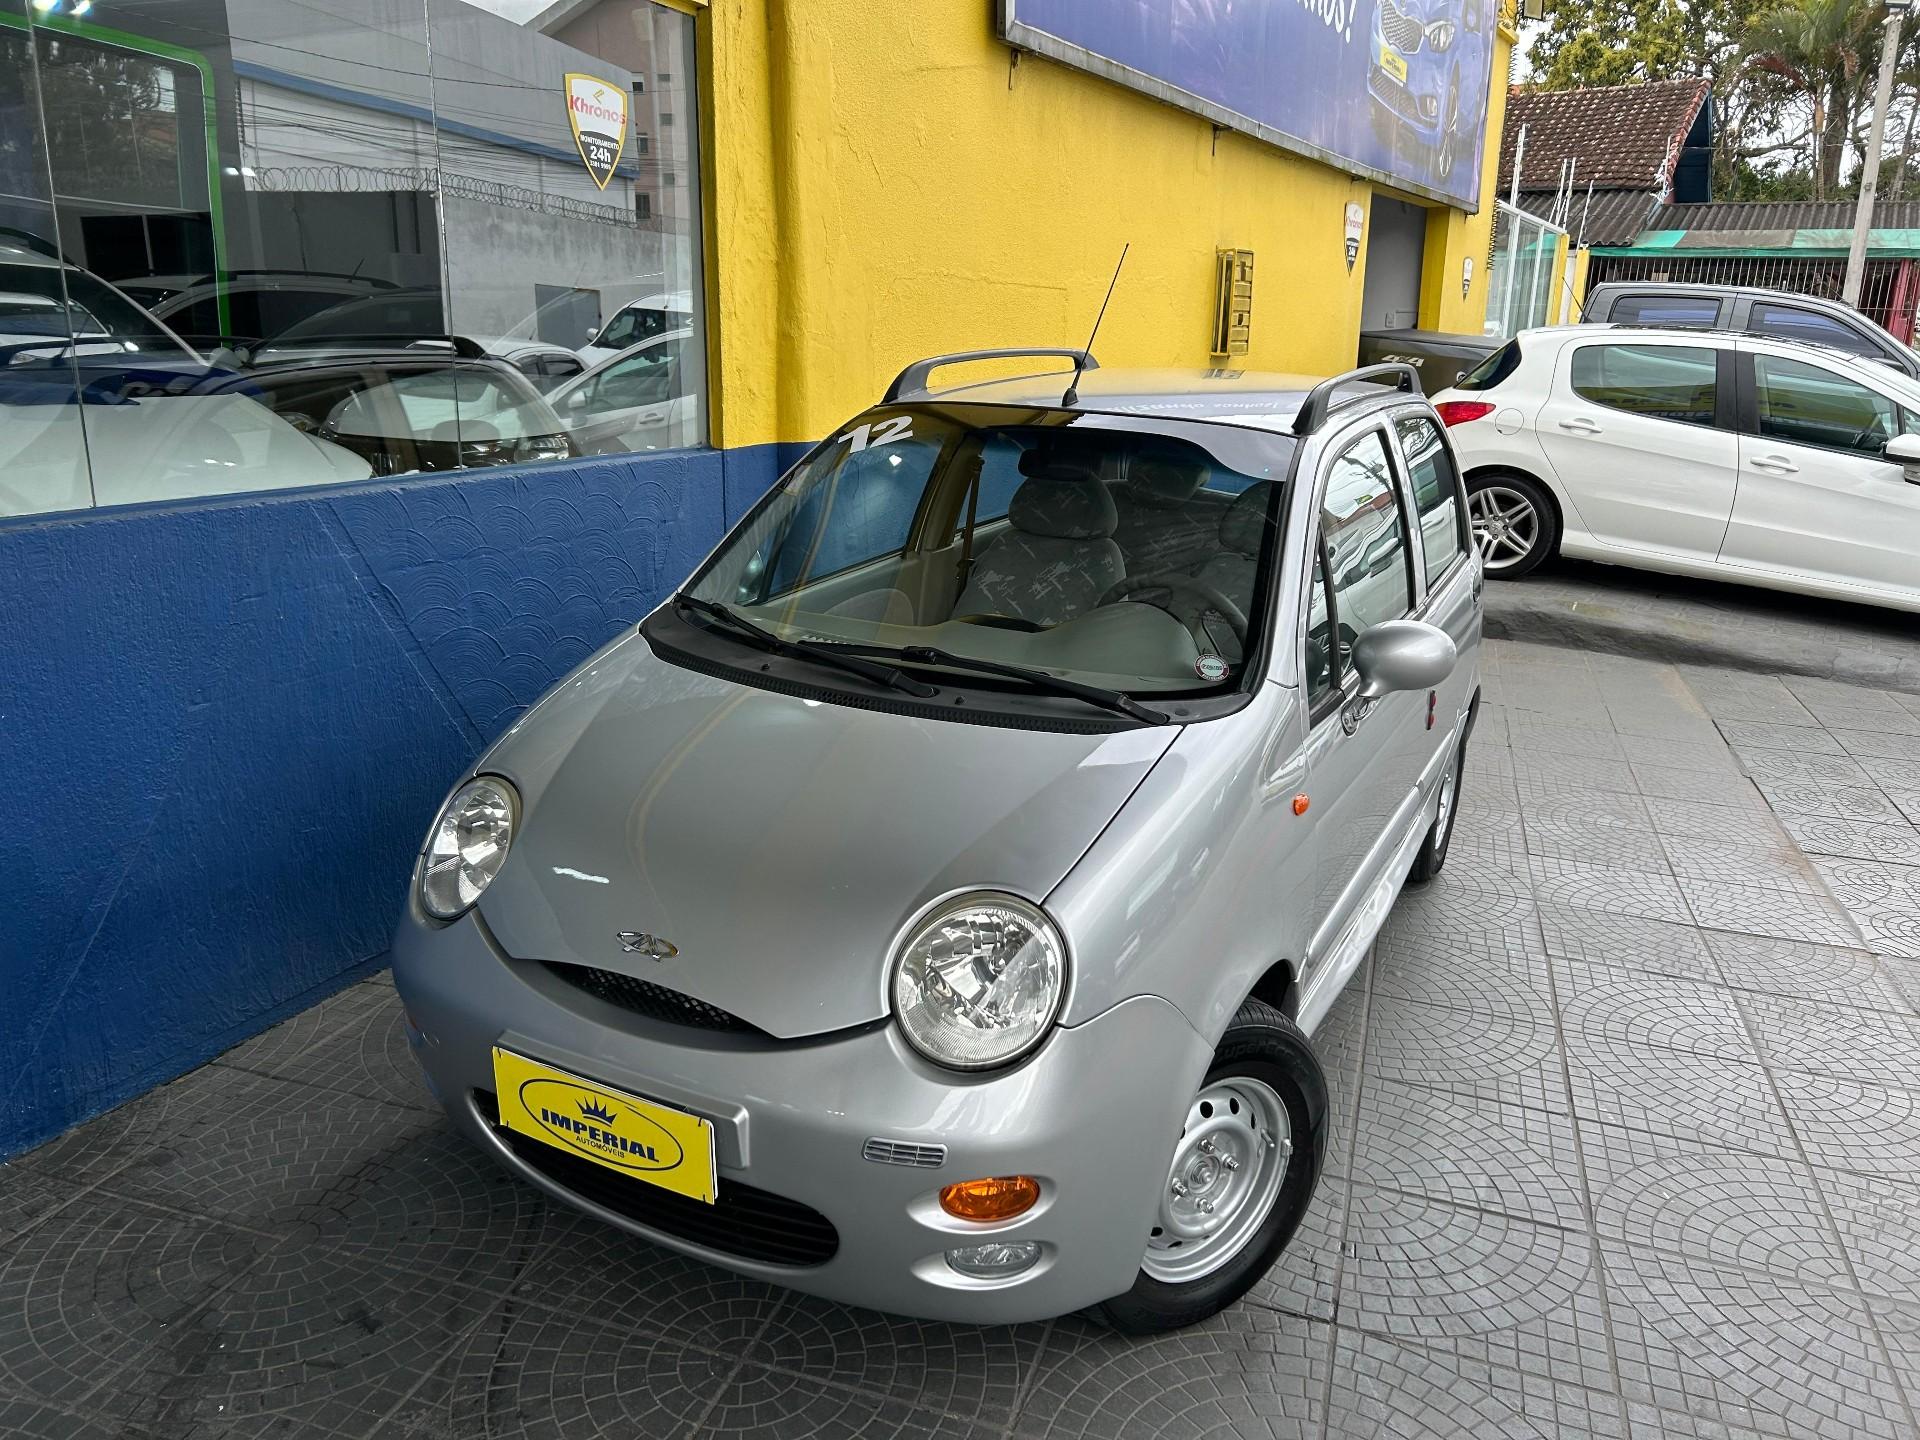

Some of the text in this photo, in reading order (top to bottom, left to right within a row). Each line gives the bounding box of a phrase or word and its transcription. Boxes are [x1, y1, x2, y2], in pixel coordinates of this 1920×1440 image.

[570, 95, 626, 125] Khronos
[580, 134, 620, 150] MONITORAMENTO
[590, 145, 611, 163] 24h
[837, 415, 914, 454] 12
[541, 1107, 660, 1163] IMPERIAL
[575, 1135, 625, 1159] AUTOMÓVEIS
